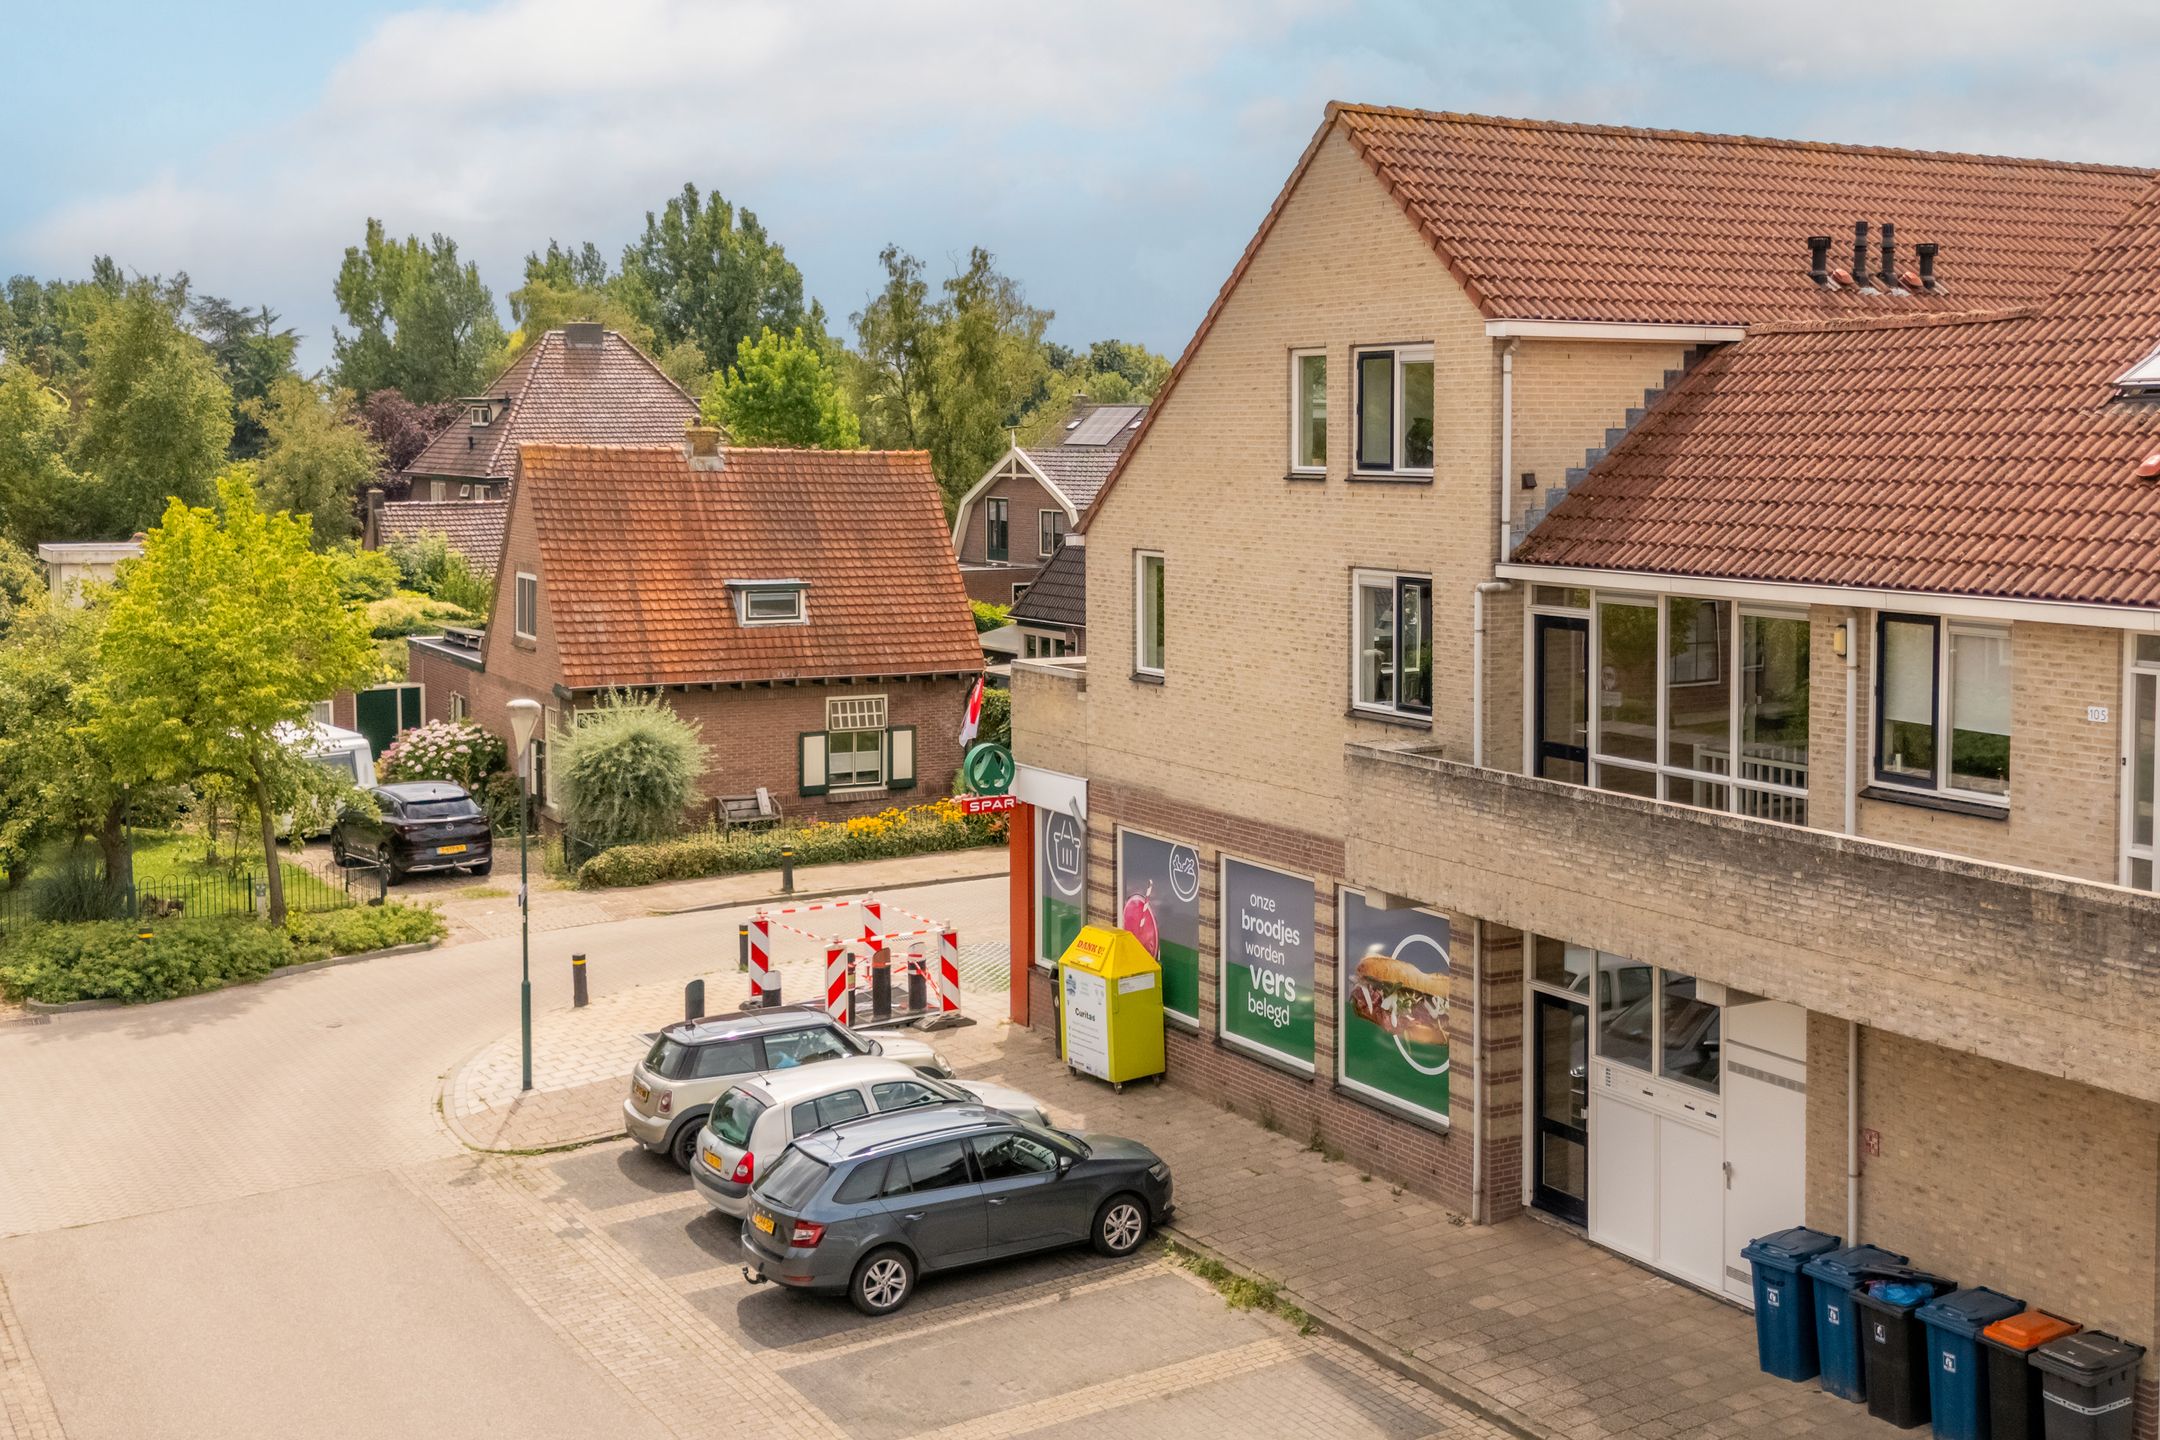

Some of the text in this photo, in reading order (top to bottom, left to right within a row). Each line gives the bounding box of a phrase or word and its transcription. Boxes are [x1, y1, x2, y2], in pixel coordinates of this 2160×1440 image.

[2090, 709, 2106, 721] 105
[969, 798, 1015, 812] SPAR
[1250, 893, 1276, 913] onze
[1241, 908, 1300, 947] broodjes
[1076, 939, 1098, 953] DANK
[1245, 941, 1285, 966] worden
[1250, 964, 1296, 1002] vers
[1074, 1006, 1096, 1022] Curitas
[1248, 991, 1290, 1028] belegd
